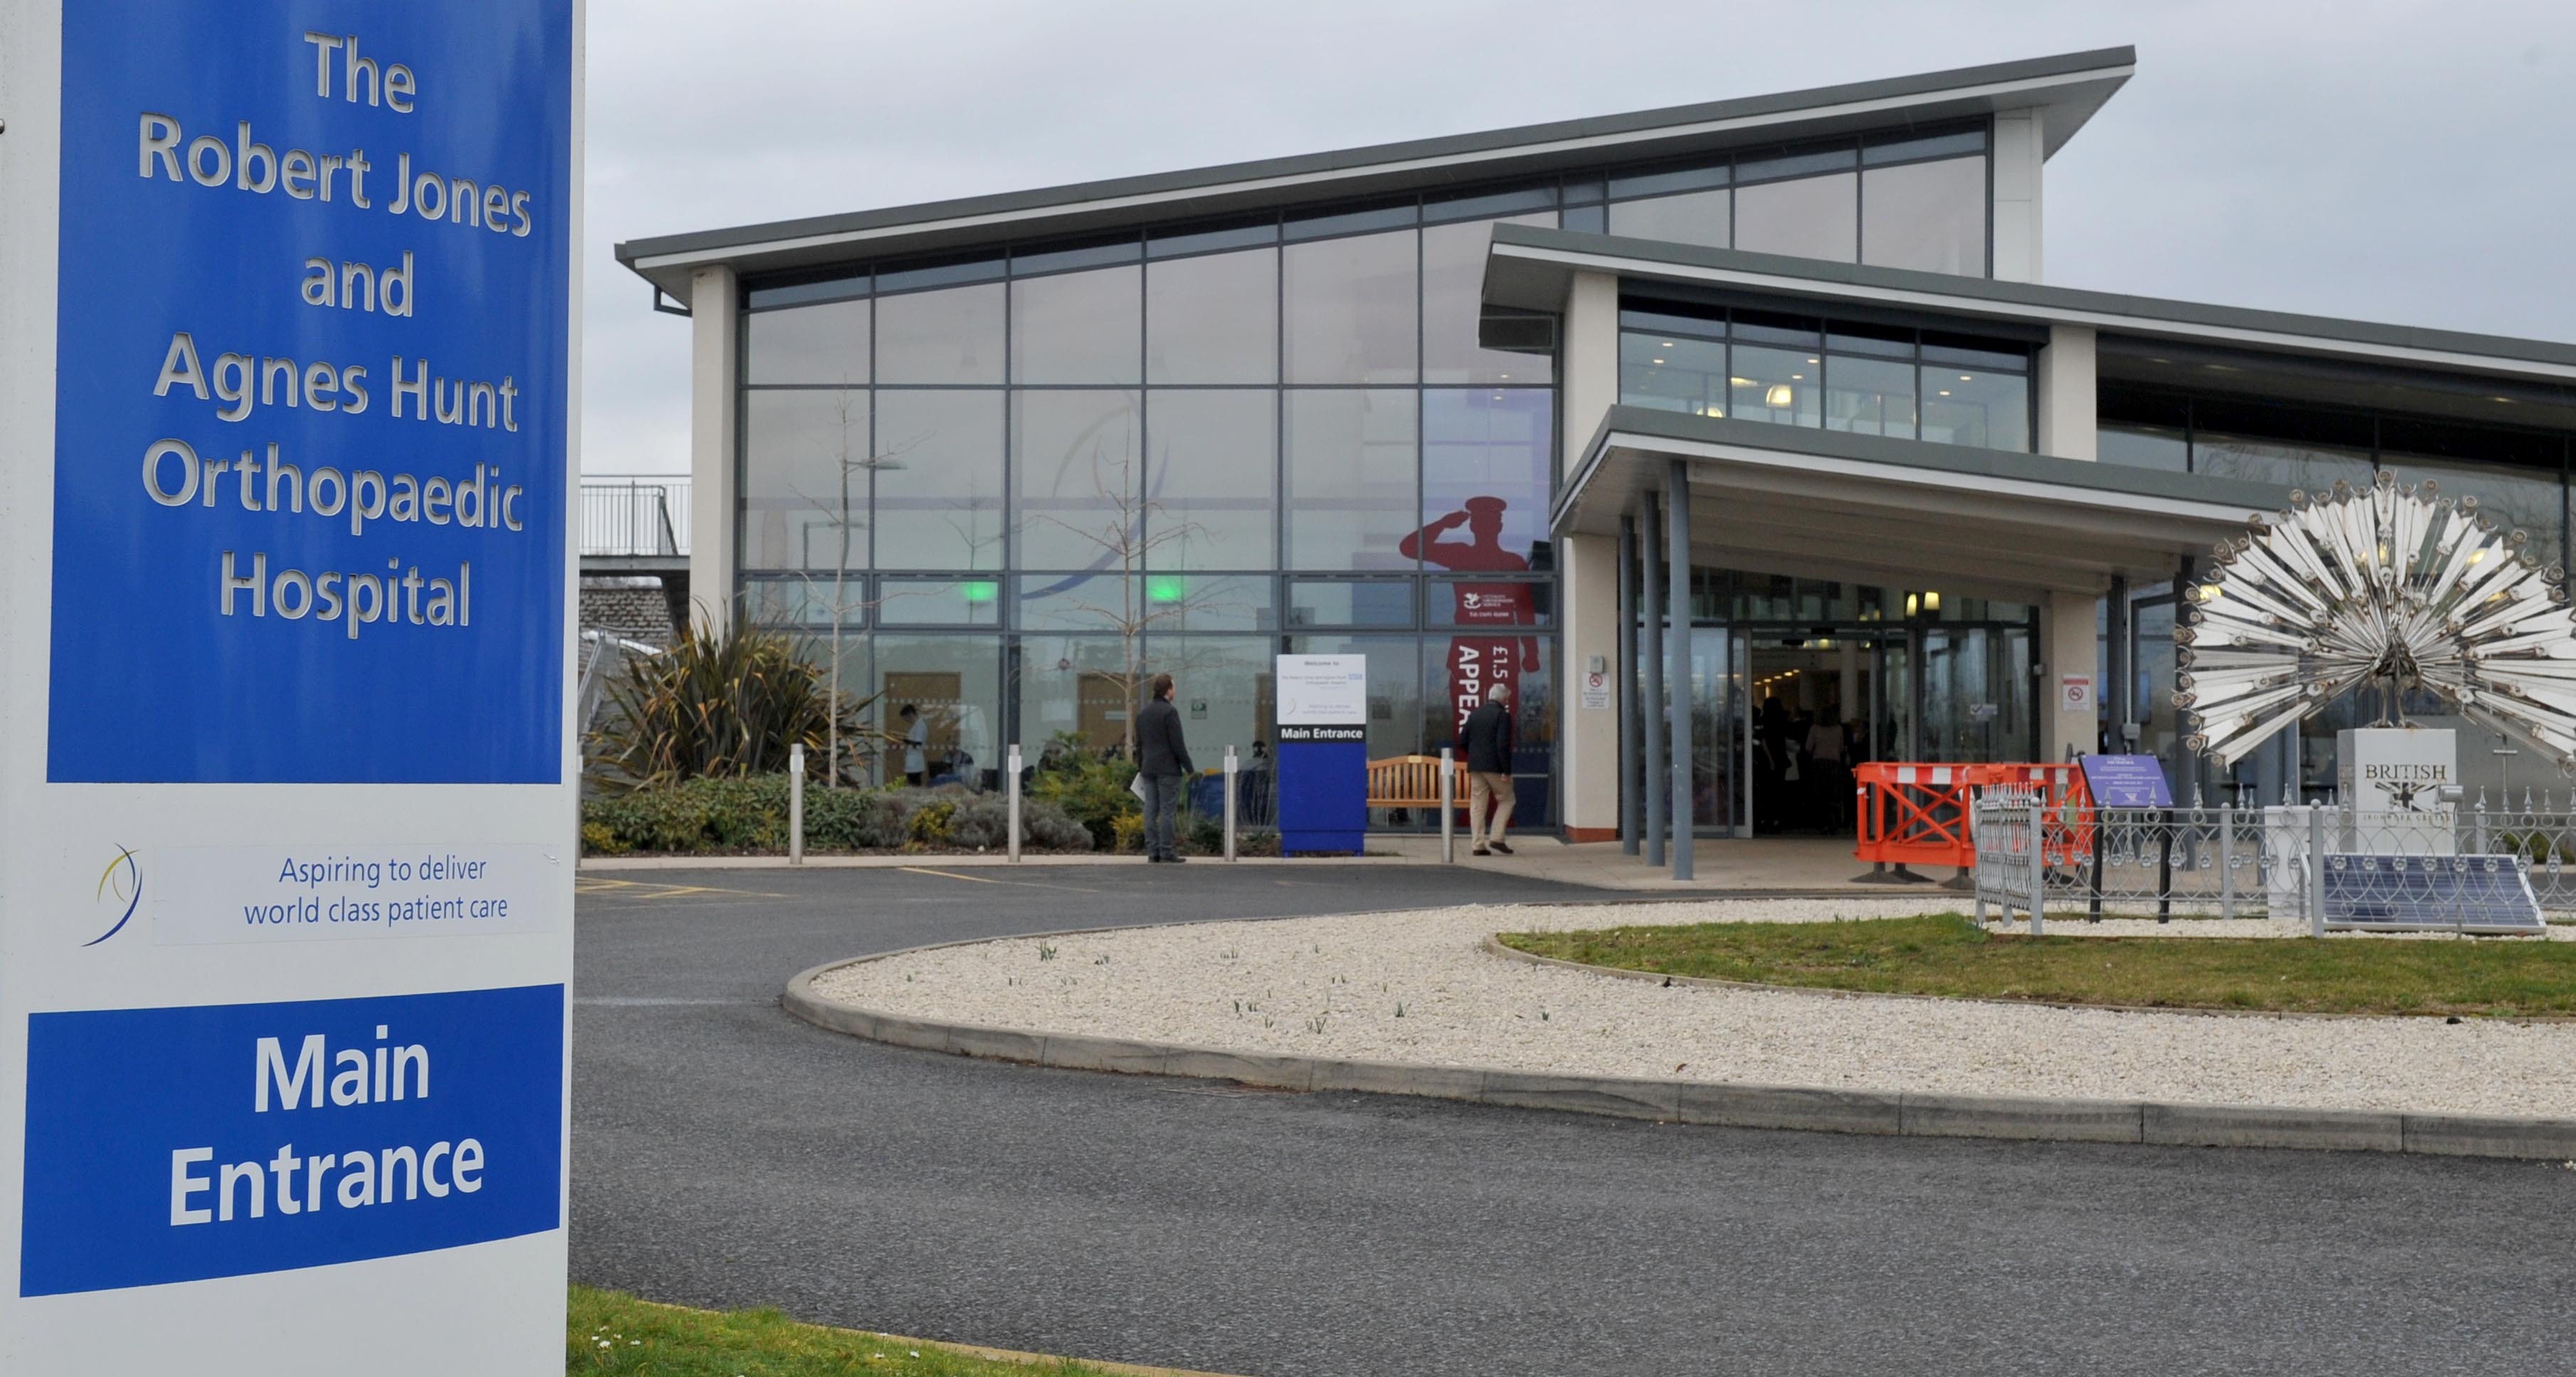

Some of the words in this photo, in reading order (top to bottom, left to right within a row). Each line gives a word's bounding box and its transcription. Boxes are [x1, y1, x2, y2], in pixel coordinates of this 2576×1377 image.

[304, 30, 417, 114] The
[139, 110, 371, 210] Robert
[388, 151, 532, 238] Jones
[301, 250, 414, 318] and
[153, 331, 369, 422] Agnes
[391, 355, 519, 432] Hunt
[142, 437, 524, 536] Orthopaedic
[221, 550, 470, 640] Hospital
[1458, 644, 1480, 735] APPEA
[1493, 645, 1508, 679] £1.5
[1281, 728, 1310, 739] Main
[1313, 728, 1364, 739] Entrance
[2365, 764, 2447, 780] BRITISH
[244, 896, 320, 925] world
[328, 896, 381, 923] class
[388, 894, 465, 927] patient
[470, 898, 508, 919] care
[279, 856, 381, 889] Aspiring
[388, 858, 412, 882] to
[419, 854, 487, 881] deliver
[255, 1024, 430, 1113] Main
[170, 1137, 484, 1227] Entrance
